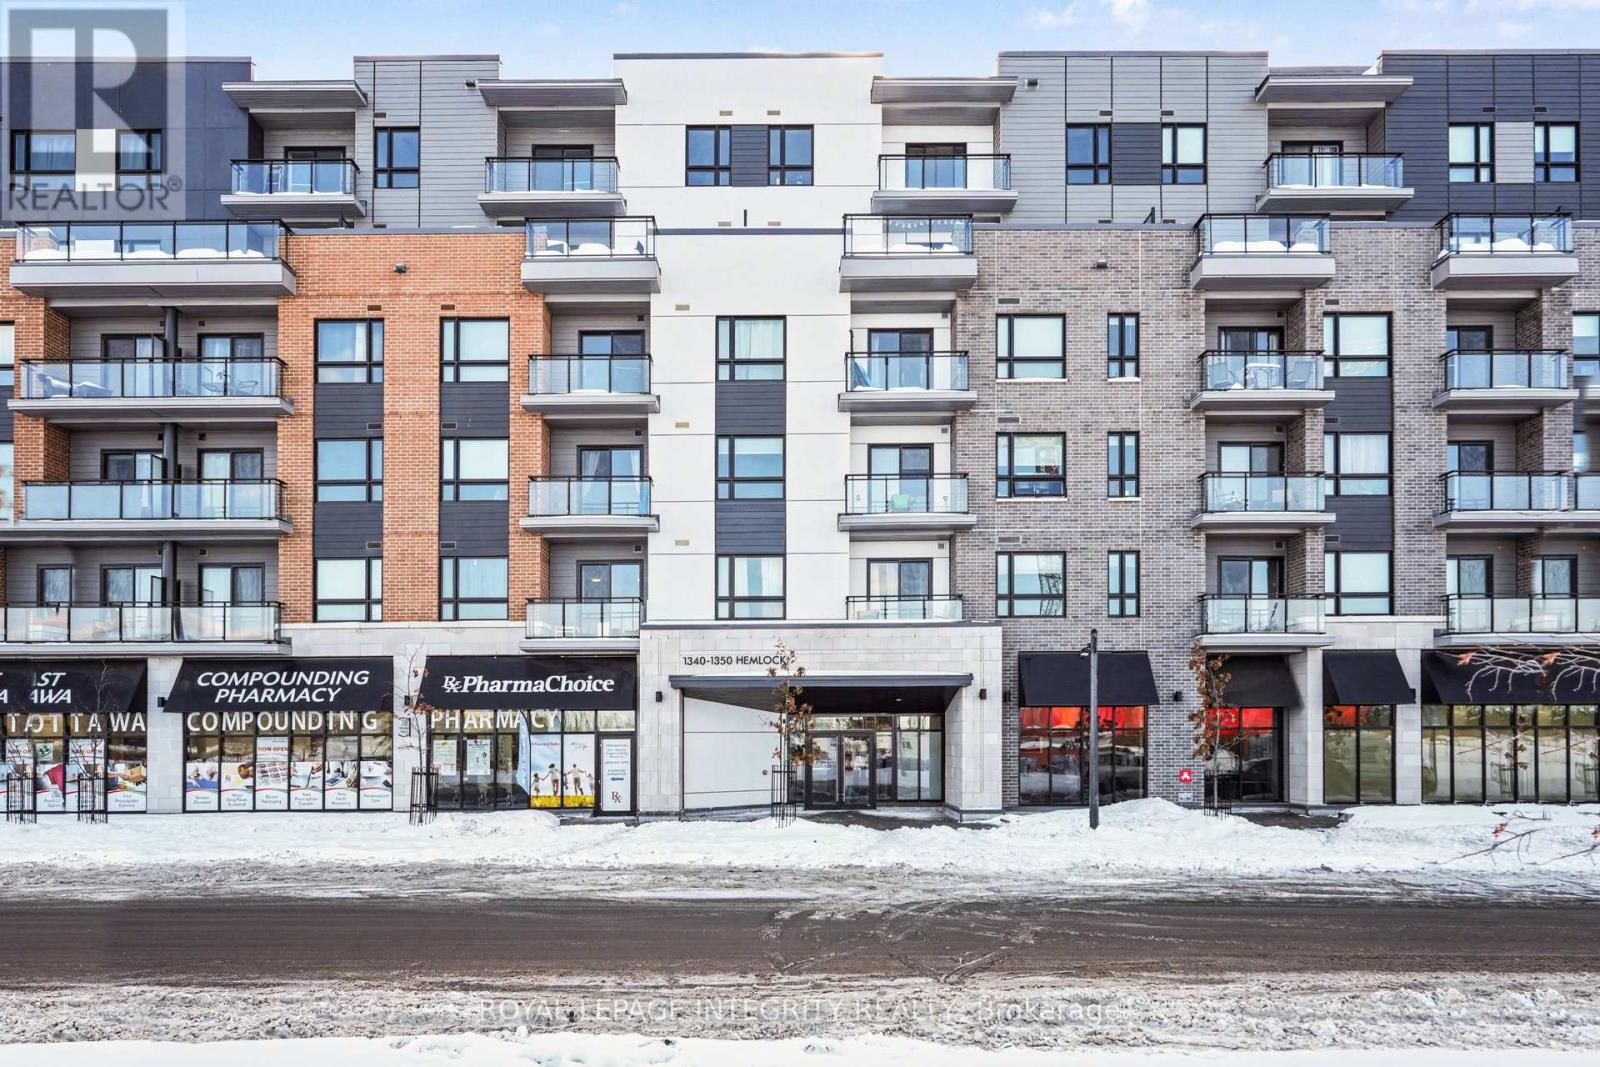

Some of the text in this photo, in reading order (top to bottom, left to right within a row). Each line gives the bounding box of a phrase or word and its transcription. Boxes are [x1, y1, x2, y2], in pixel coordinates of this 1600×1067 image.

[682, 656, 733, 666] 1340-1350
[197, 671, 370, 687] COMPOUNDING
[215, 687, 342, 704] PHARMACY
[186, 710, 378, 733] COMPOUNDING
